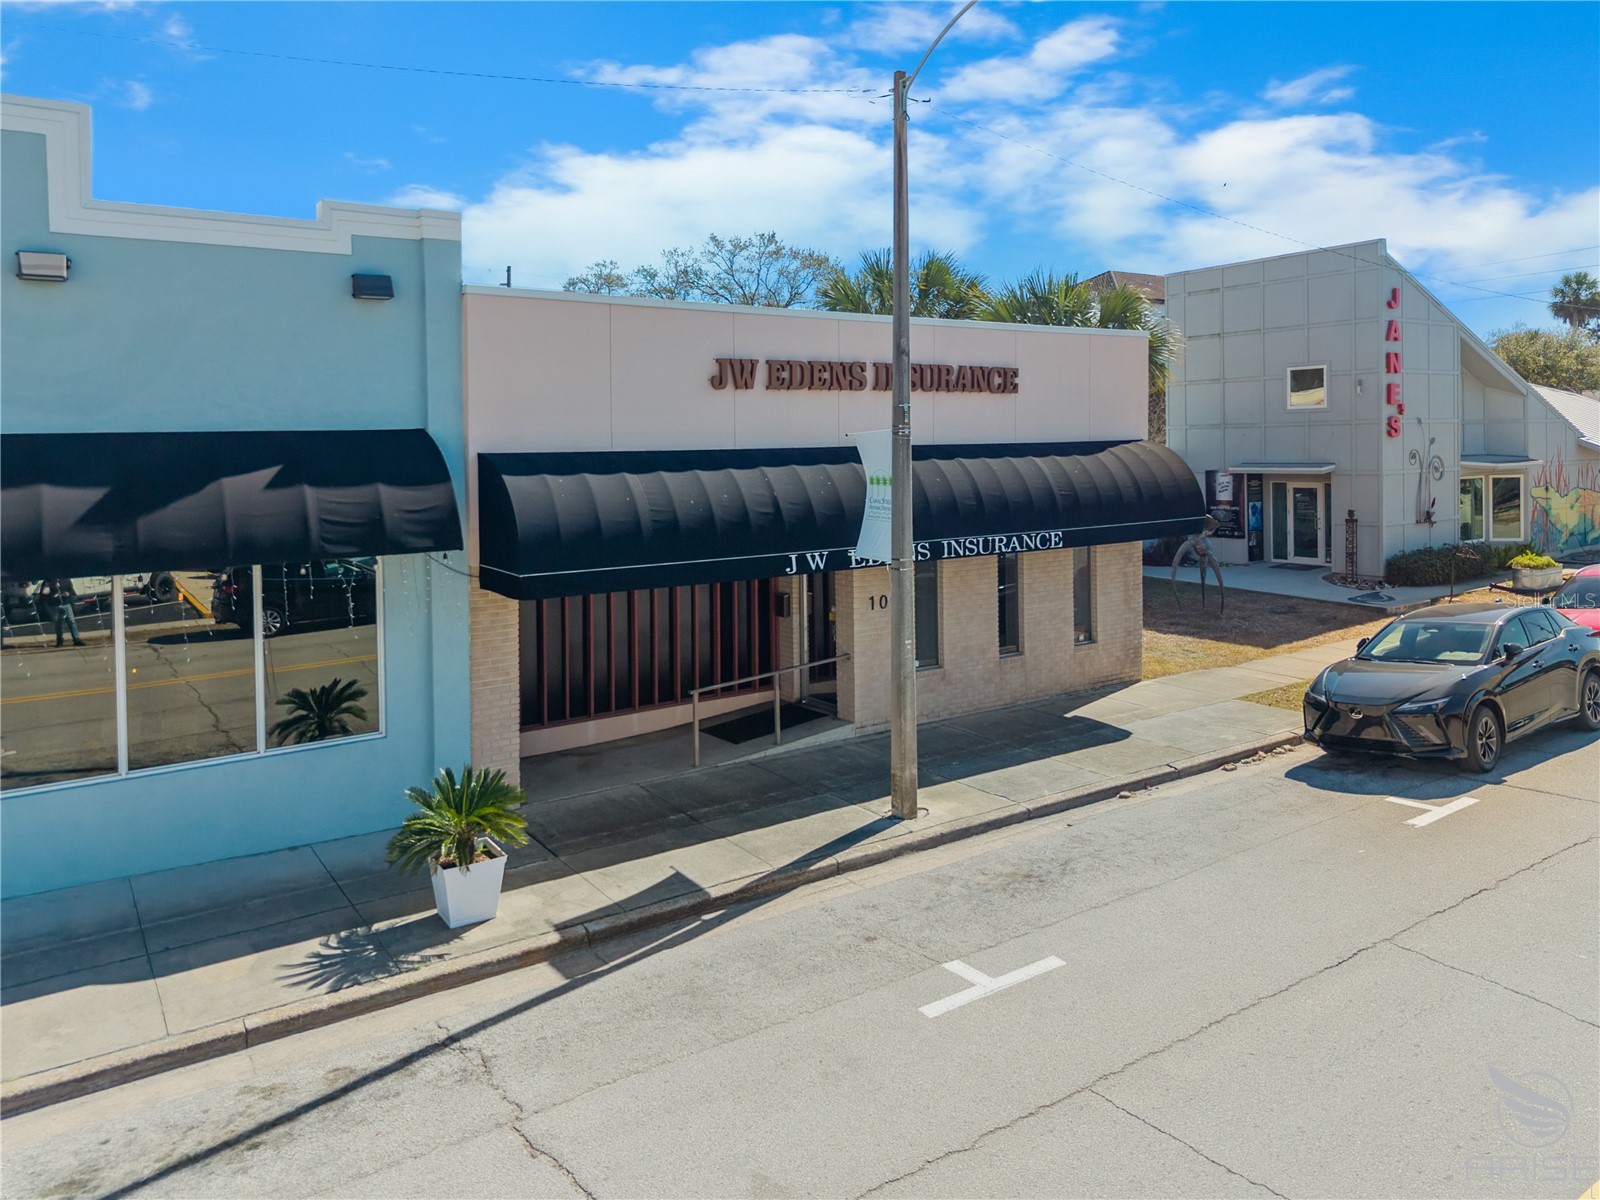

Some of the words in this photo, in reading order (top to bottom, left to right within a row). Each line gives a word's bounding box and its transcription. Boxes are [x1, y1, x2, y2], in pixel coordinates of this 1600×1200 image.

[710, 358, 759, 390] JW
[766, 359, 867, 391] EDENS
[1386, 287, 1405, 438] JANE'S
[941, 531, 1063, 558] INSURANCE
